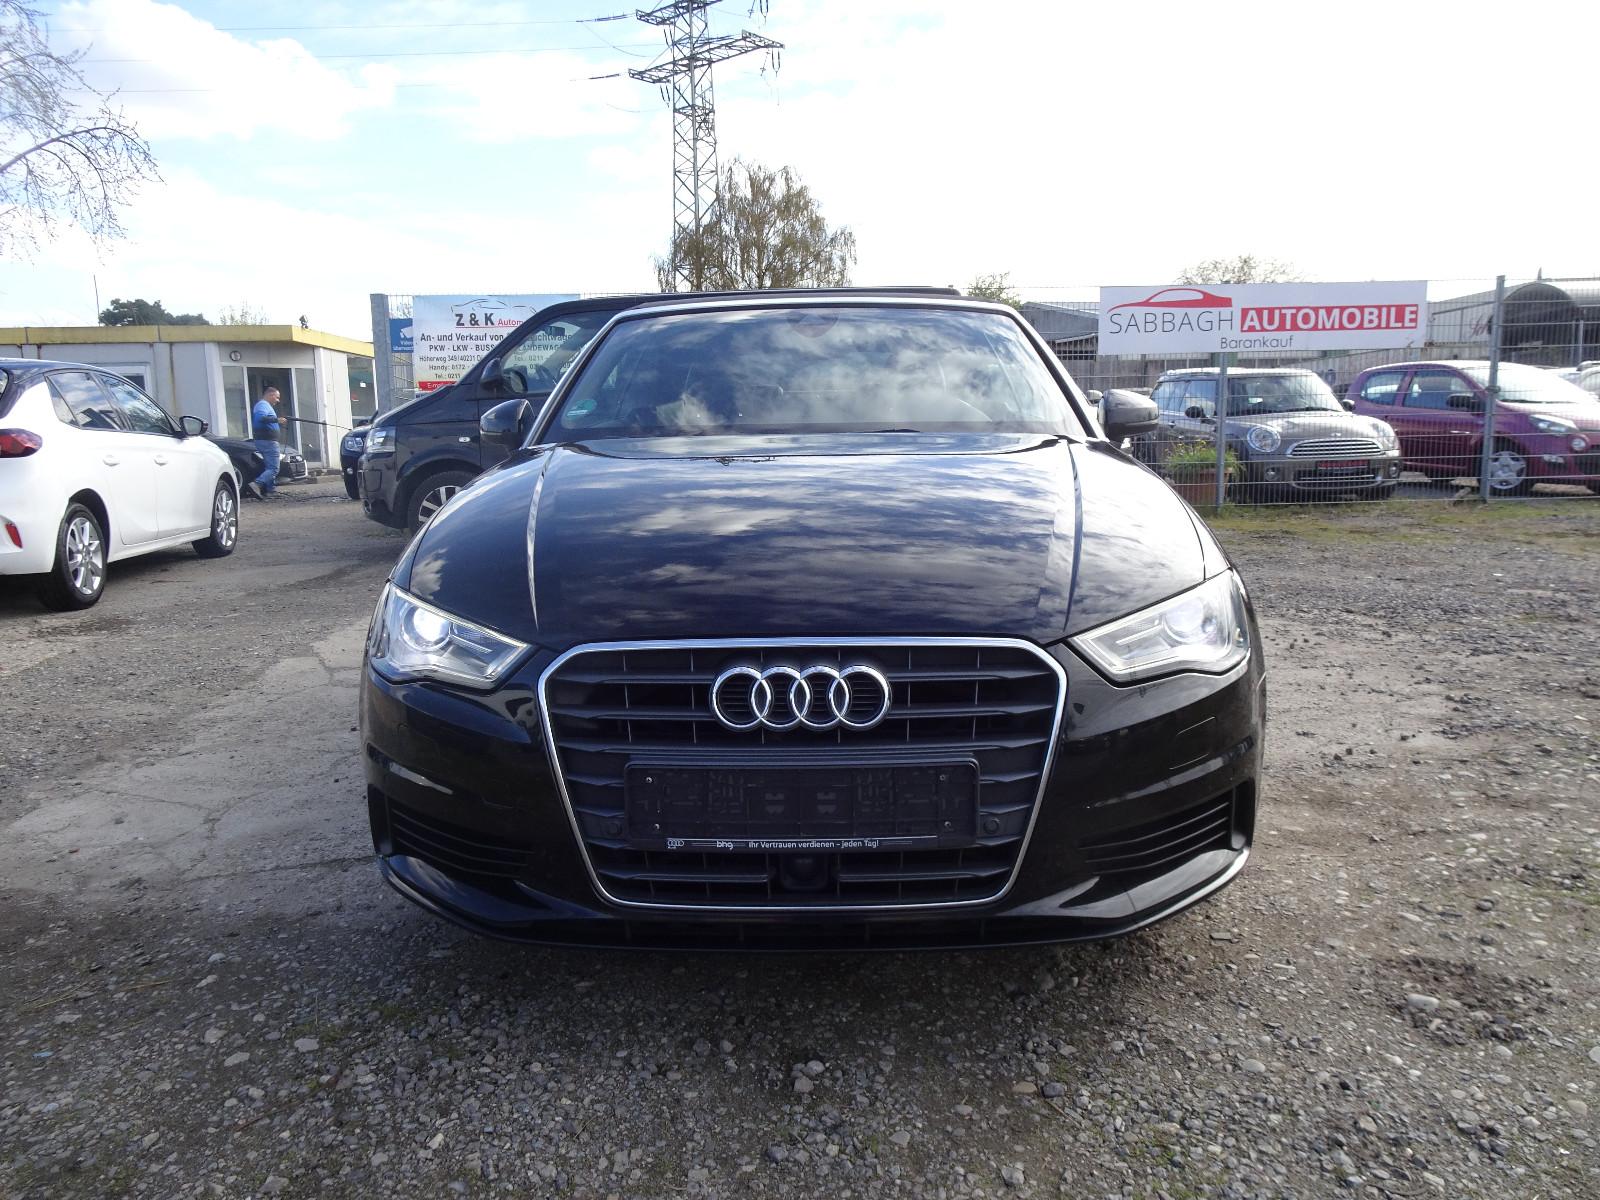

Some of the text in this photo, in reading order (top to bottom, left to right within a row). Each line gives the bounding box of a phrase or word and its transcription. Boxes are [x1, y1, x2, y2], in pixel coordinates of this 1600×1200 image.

[455, 312, 524, 326] Z & K Autom
[1109, 306, 1417, 334] SABBAGH AUTOMOBILE
[420, 333, 434, 342] An-
[437, 333, 453, 342] und
[456, 333, 487, 342] Verkauf
[1220, 335, 1294, 349] Barankauf
[475, 344, 495, 352] BUSS
[716, 840, 734, 851] bhg
[798, 840, 835, 848] verdienen
[841, 840, 862, 849] jeden
[864, 839, 879, 849] Tag!
